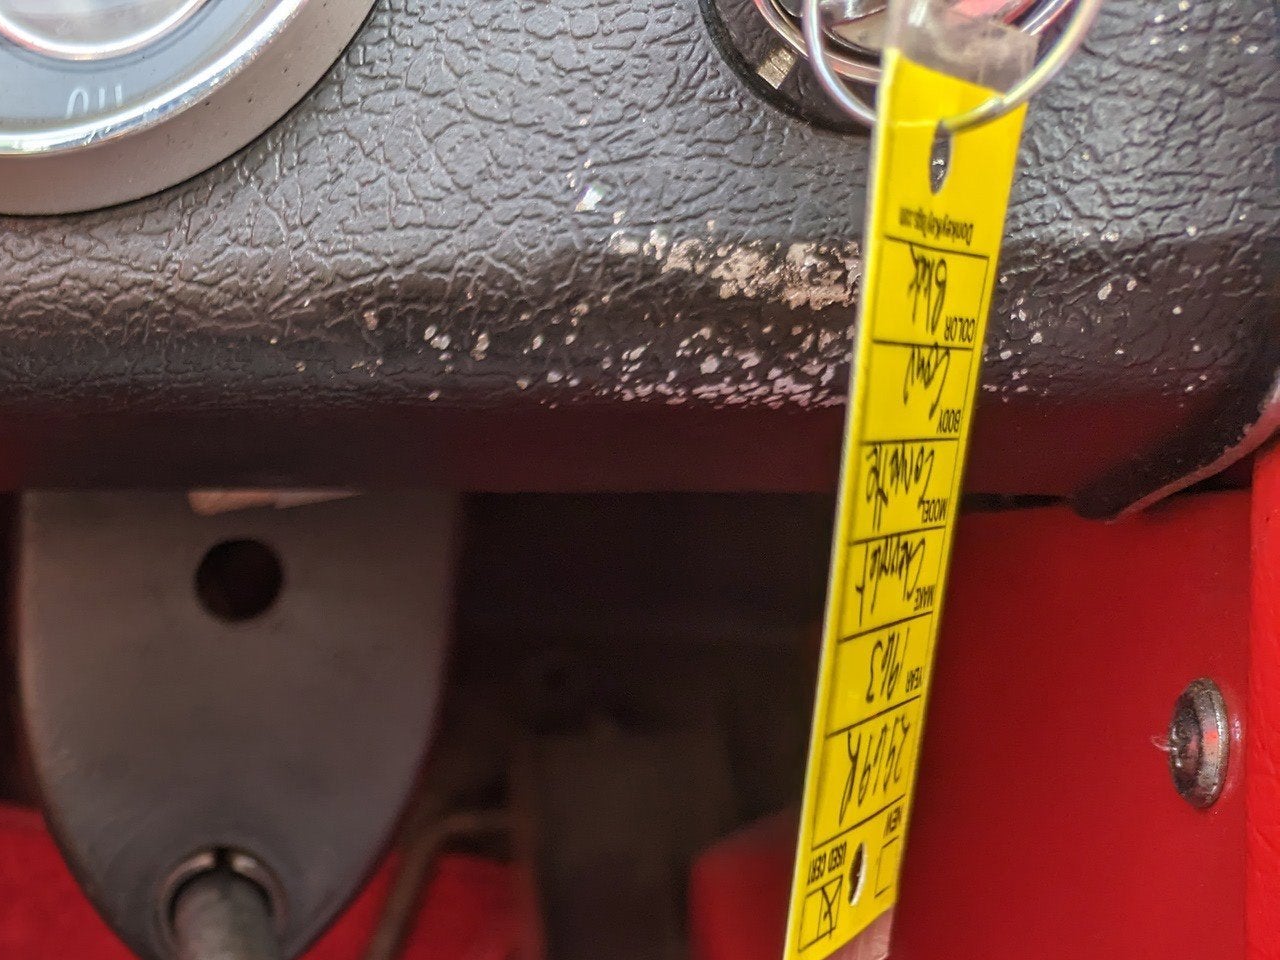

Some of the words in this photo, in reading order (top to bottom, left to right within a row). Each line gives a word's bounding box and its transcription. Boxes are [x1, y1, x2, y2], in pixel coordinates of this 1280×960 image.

[943, 316, 976, 342] COLOR
[936, 409, 961, 433] BODY
[921, 498, 947, 524] MODEL
[913, 585, 935, 611] MAKE
[866, 627, 909, 703] 1963
[906, 667, 923, 693] YEAR
[883, 806, 902, 838] NEW
[807, 853, 825, 885] CERT
[826, 841, 847, 873] USED
